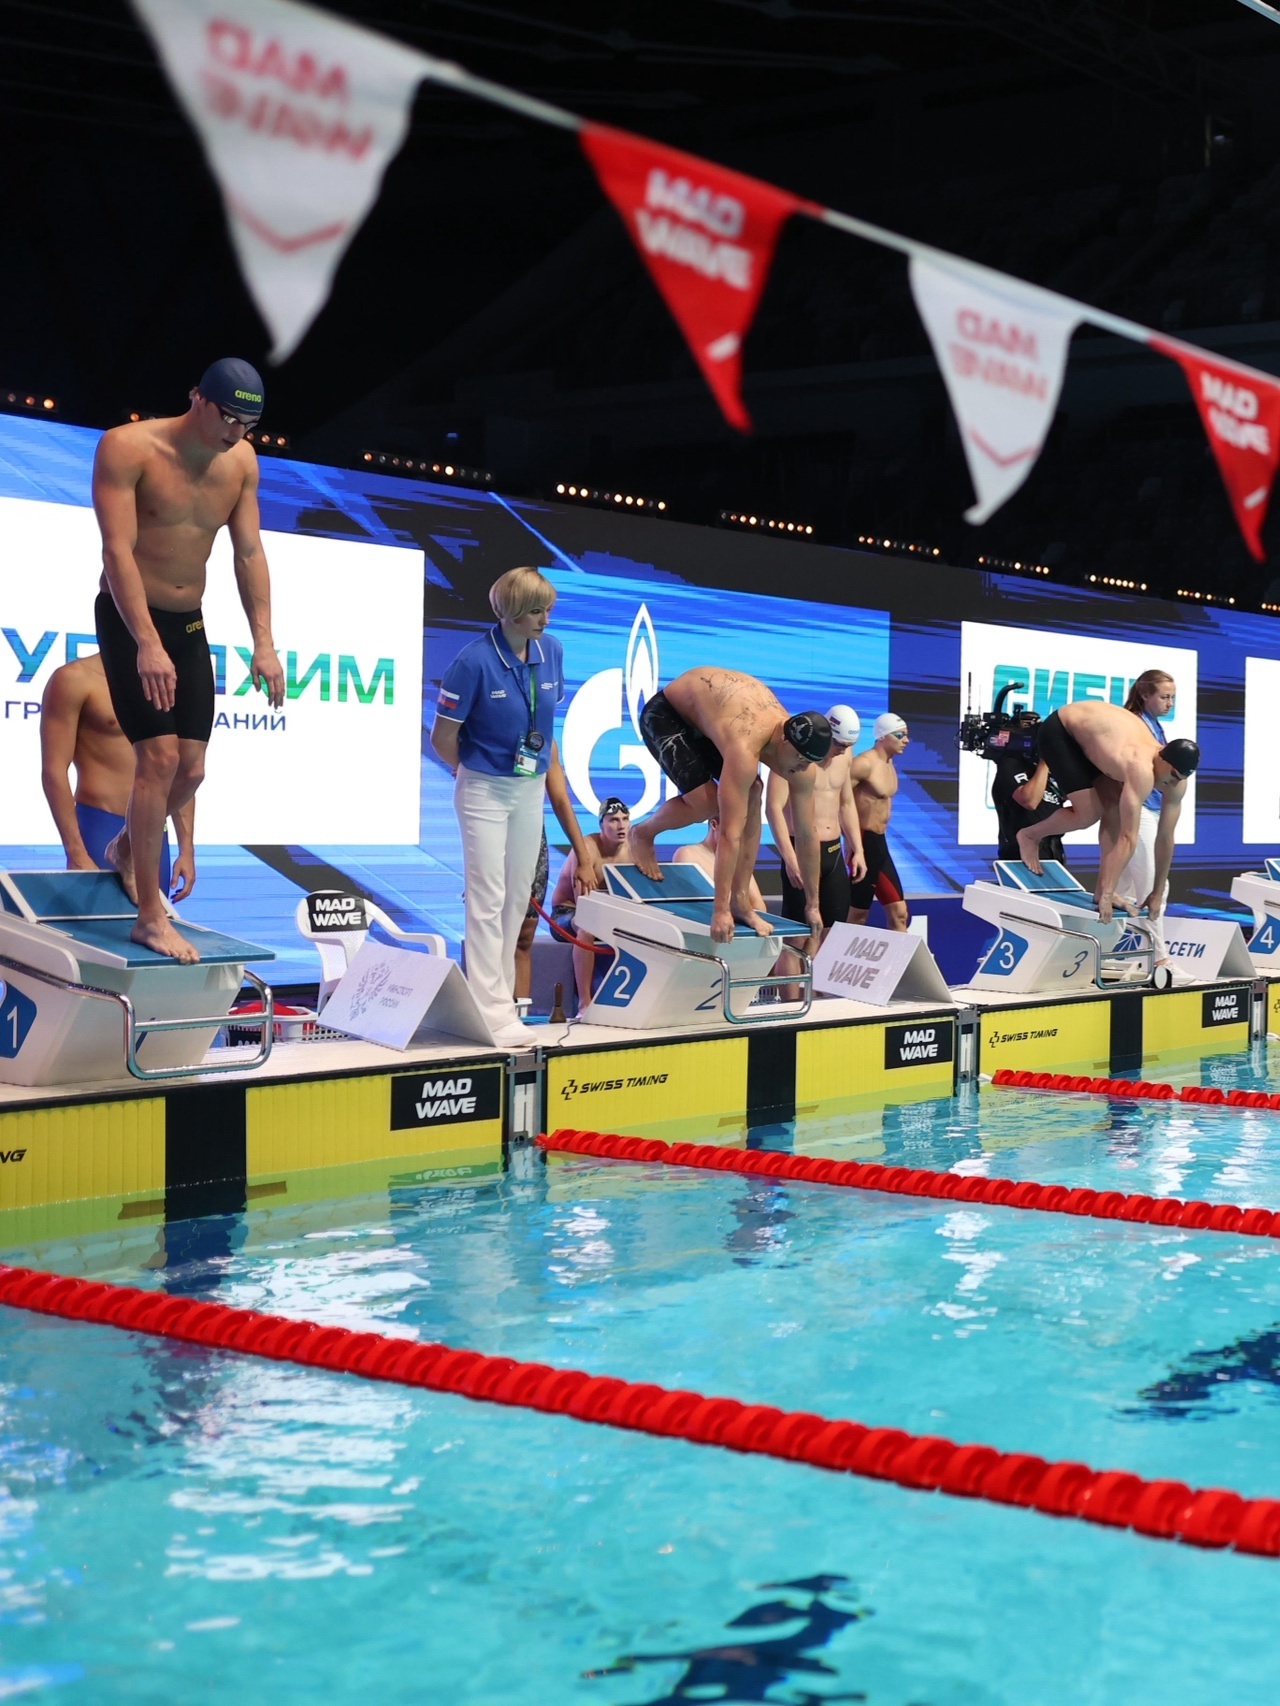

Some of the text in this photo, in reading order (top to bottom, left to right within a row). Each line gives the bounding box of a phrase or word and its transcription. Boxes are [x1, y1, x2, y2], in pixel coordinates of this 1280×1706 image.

[234, 389, 262, 403] arena
[1200, 370, 1258, 421] MAD
[315, 897, 356, 912] MAD
[312, 911, 362, 927] WAVE
[1260, 925, 1275, 950] 4
[843, 936, 889, 963] MAD
[1000, 941, 1015, 969] 3
[1165, 941, 1206, 958] СЕТИ
[827, 960, 880, 990] WAVE
[1062, 950, 1088, 979] 3
[613, 965, 632, 1001] 2
[1214, 994, 1237, 1008] MAD
[1212, 1007, 1239, 1021] WAVE
[7, 1005, 19, 1049] 1
[903, 1028, 936, 1046] MAD
[1000, 1028, 1058, 1043] SWISS TIMING
[900, 1043, 938, 1061] WAVE
[421, 1077, 472, 1099] MAD
[579, 1073, 669, 1094] SWISS TIMING
[415, 1097, 476, 1120] WAVE
